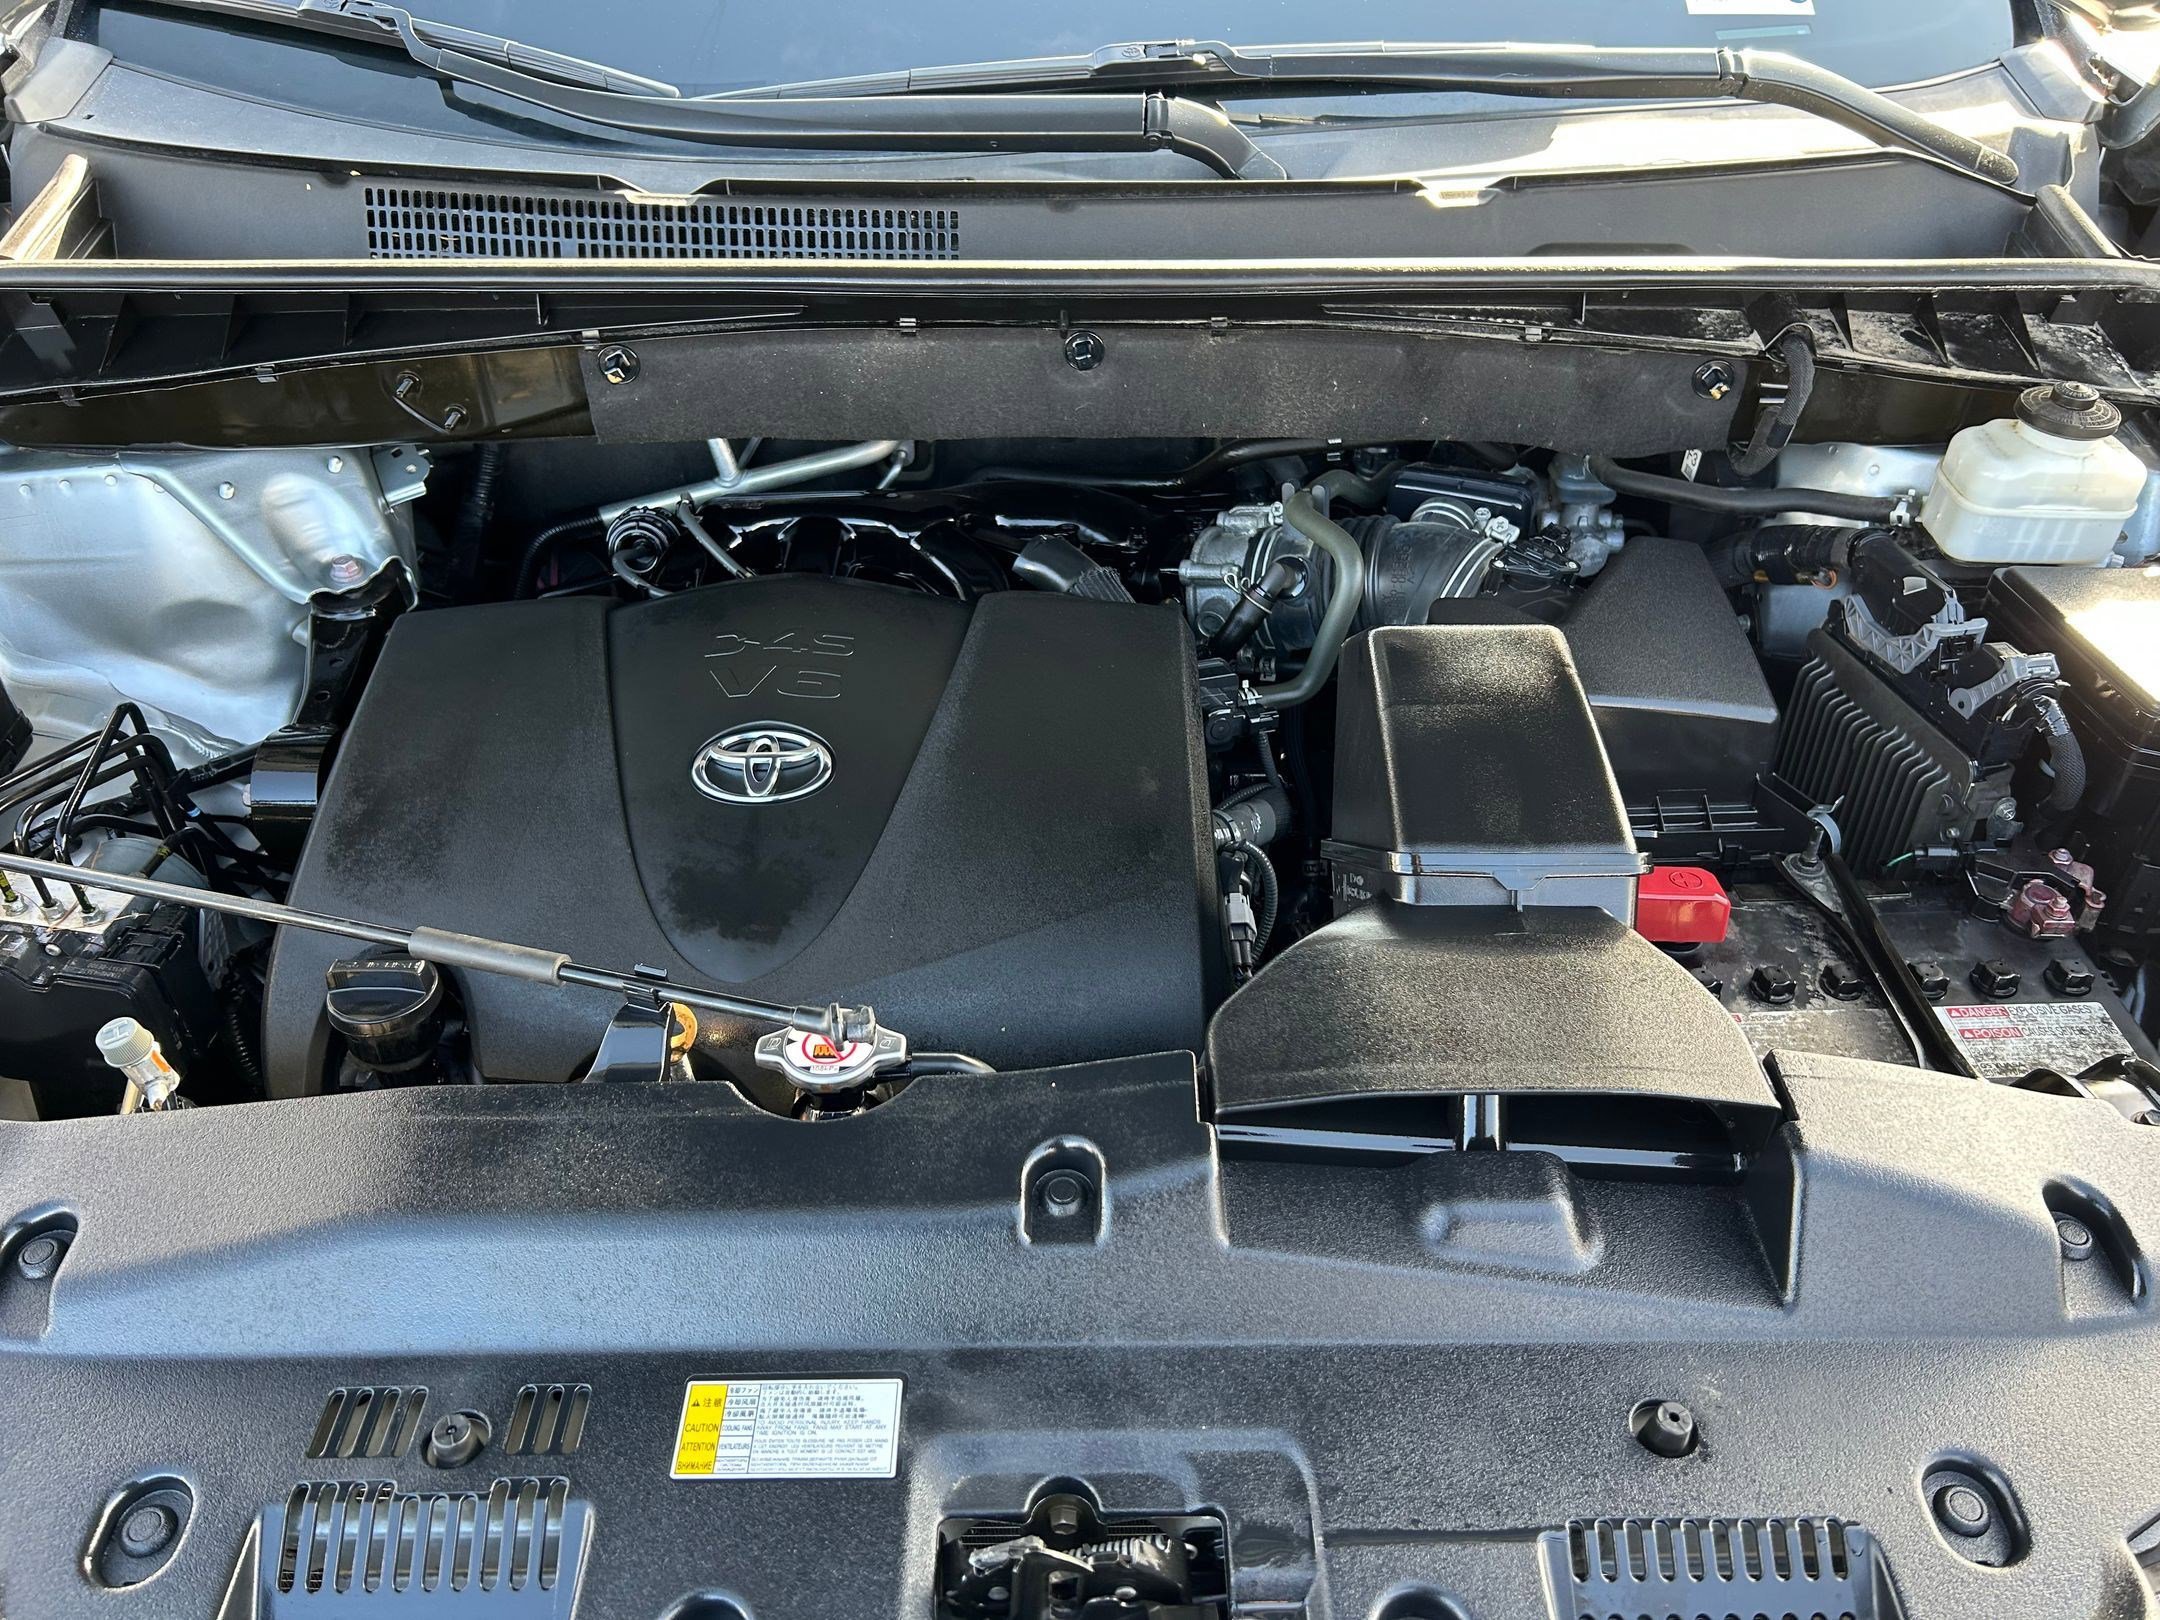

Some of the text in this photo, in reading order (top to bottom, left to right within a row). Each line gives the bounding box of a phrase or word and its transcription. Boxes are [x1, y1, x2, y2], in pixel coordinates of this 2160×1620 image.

[1960, 1004, 2092, 1017] DANGER EXPLOSIVE GASES
[103, 1019, 129, 1045] H
[1974, 1028, 2020, 1038] POISON
[2021, 1026, 2057, 1036] CAUSES
[684, 1423, 719, 1432] CAUTION
[681, 1442, 715, 1451] ATTENTION
[677, 1461, 712, 1470] ВНИМАНИЕ
